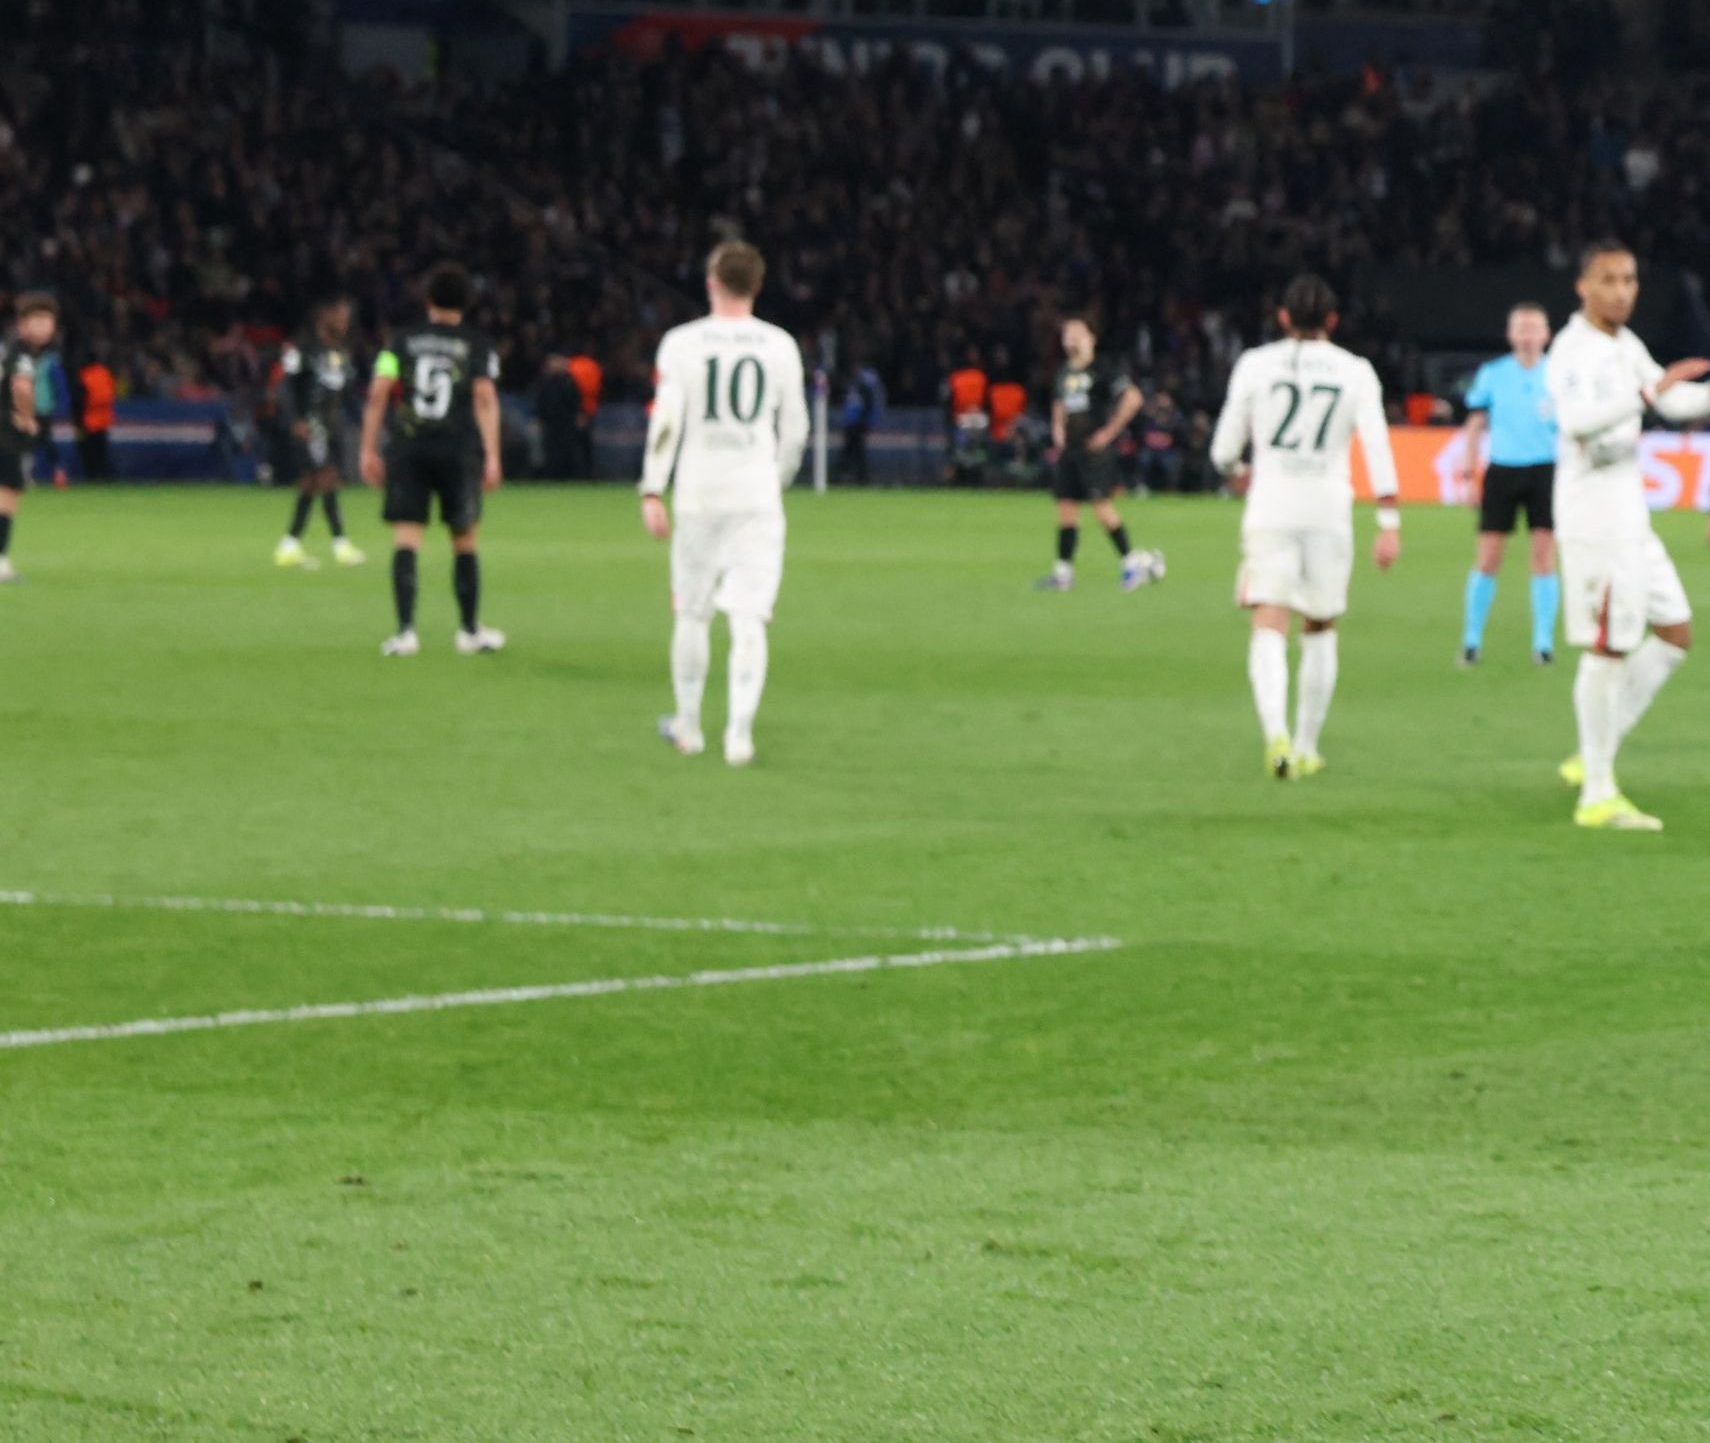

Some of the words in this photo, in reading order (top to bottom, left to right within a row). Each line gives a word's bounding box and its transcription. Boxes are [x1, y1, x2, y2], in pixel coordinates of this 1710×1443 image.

[411, 354, 454, 420] 5
[703, 353, 767, 426] 10
[1269, 379, 1344, 452] 27
